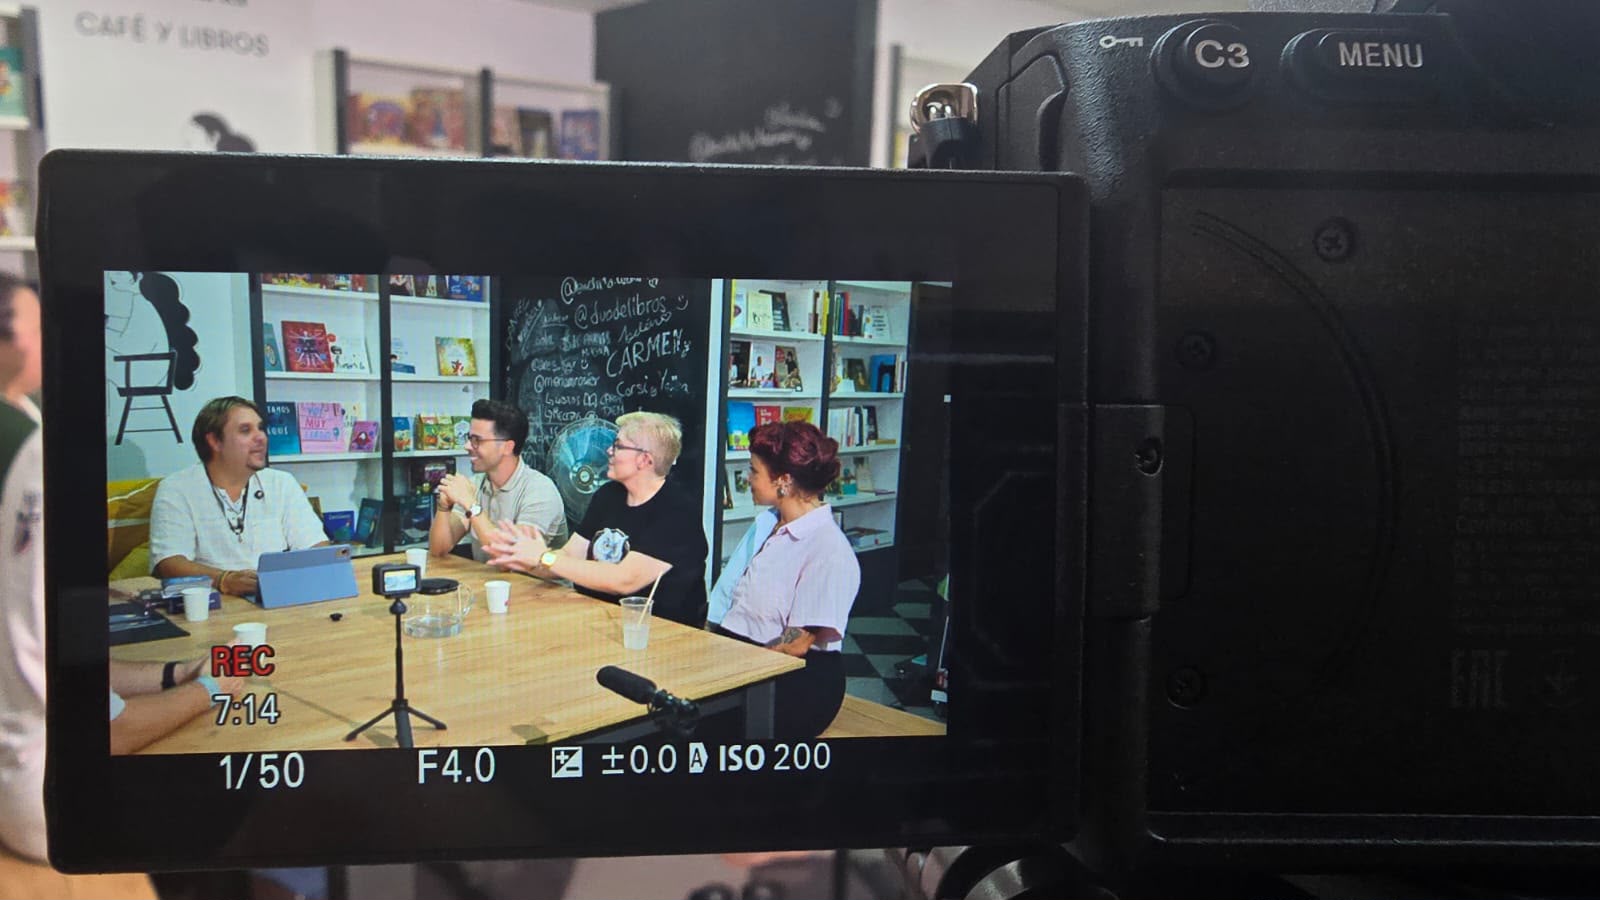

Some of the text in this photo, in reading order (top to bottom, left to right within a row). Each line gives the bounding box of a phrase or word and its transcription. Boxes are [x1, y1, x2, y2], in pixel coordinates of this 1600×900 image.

[75, 11, 270, 57] CAFÉ Y LIBROS
[1195, 40, 1249, 68] C3
[1340, 42, 1424, 68] MENU
[606, 328, 684, 378] CARMEN
[211, 645, 275, 677] REC
[213, 693, 280, 725] 7:14
[220, 752, 304, 789] 1/50
[417, 747, 496, 784] F4.0
[602, 744, 677, 774] ±0.0
[719, 744, 766, 771] ISO
[773, 742, 831, 770] 200
